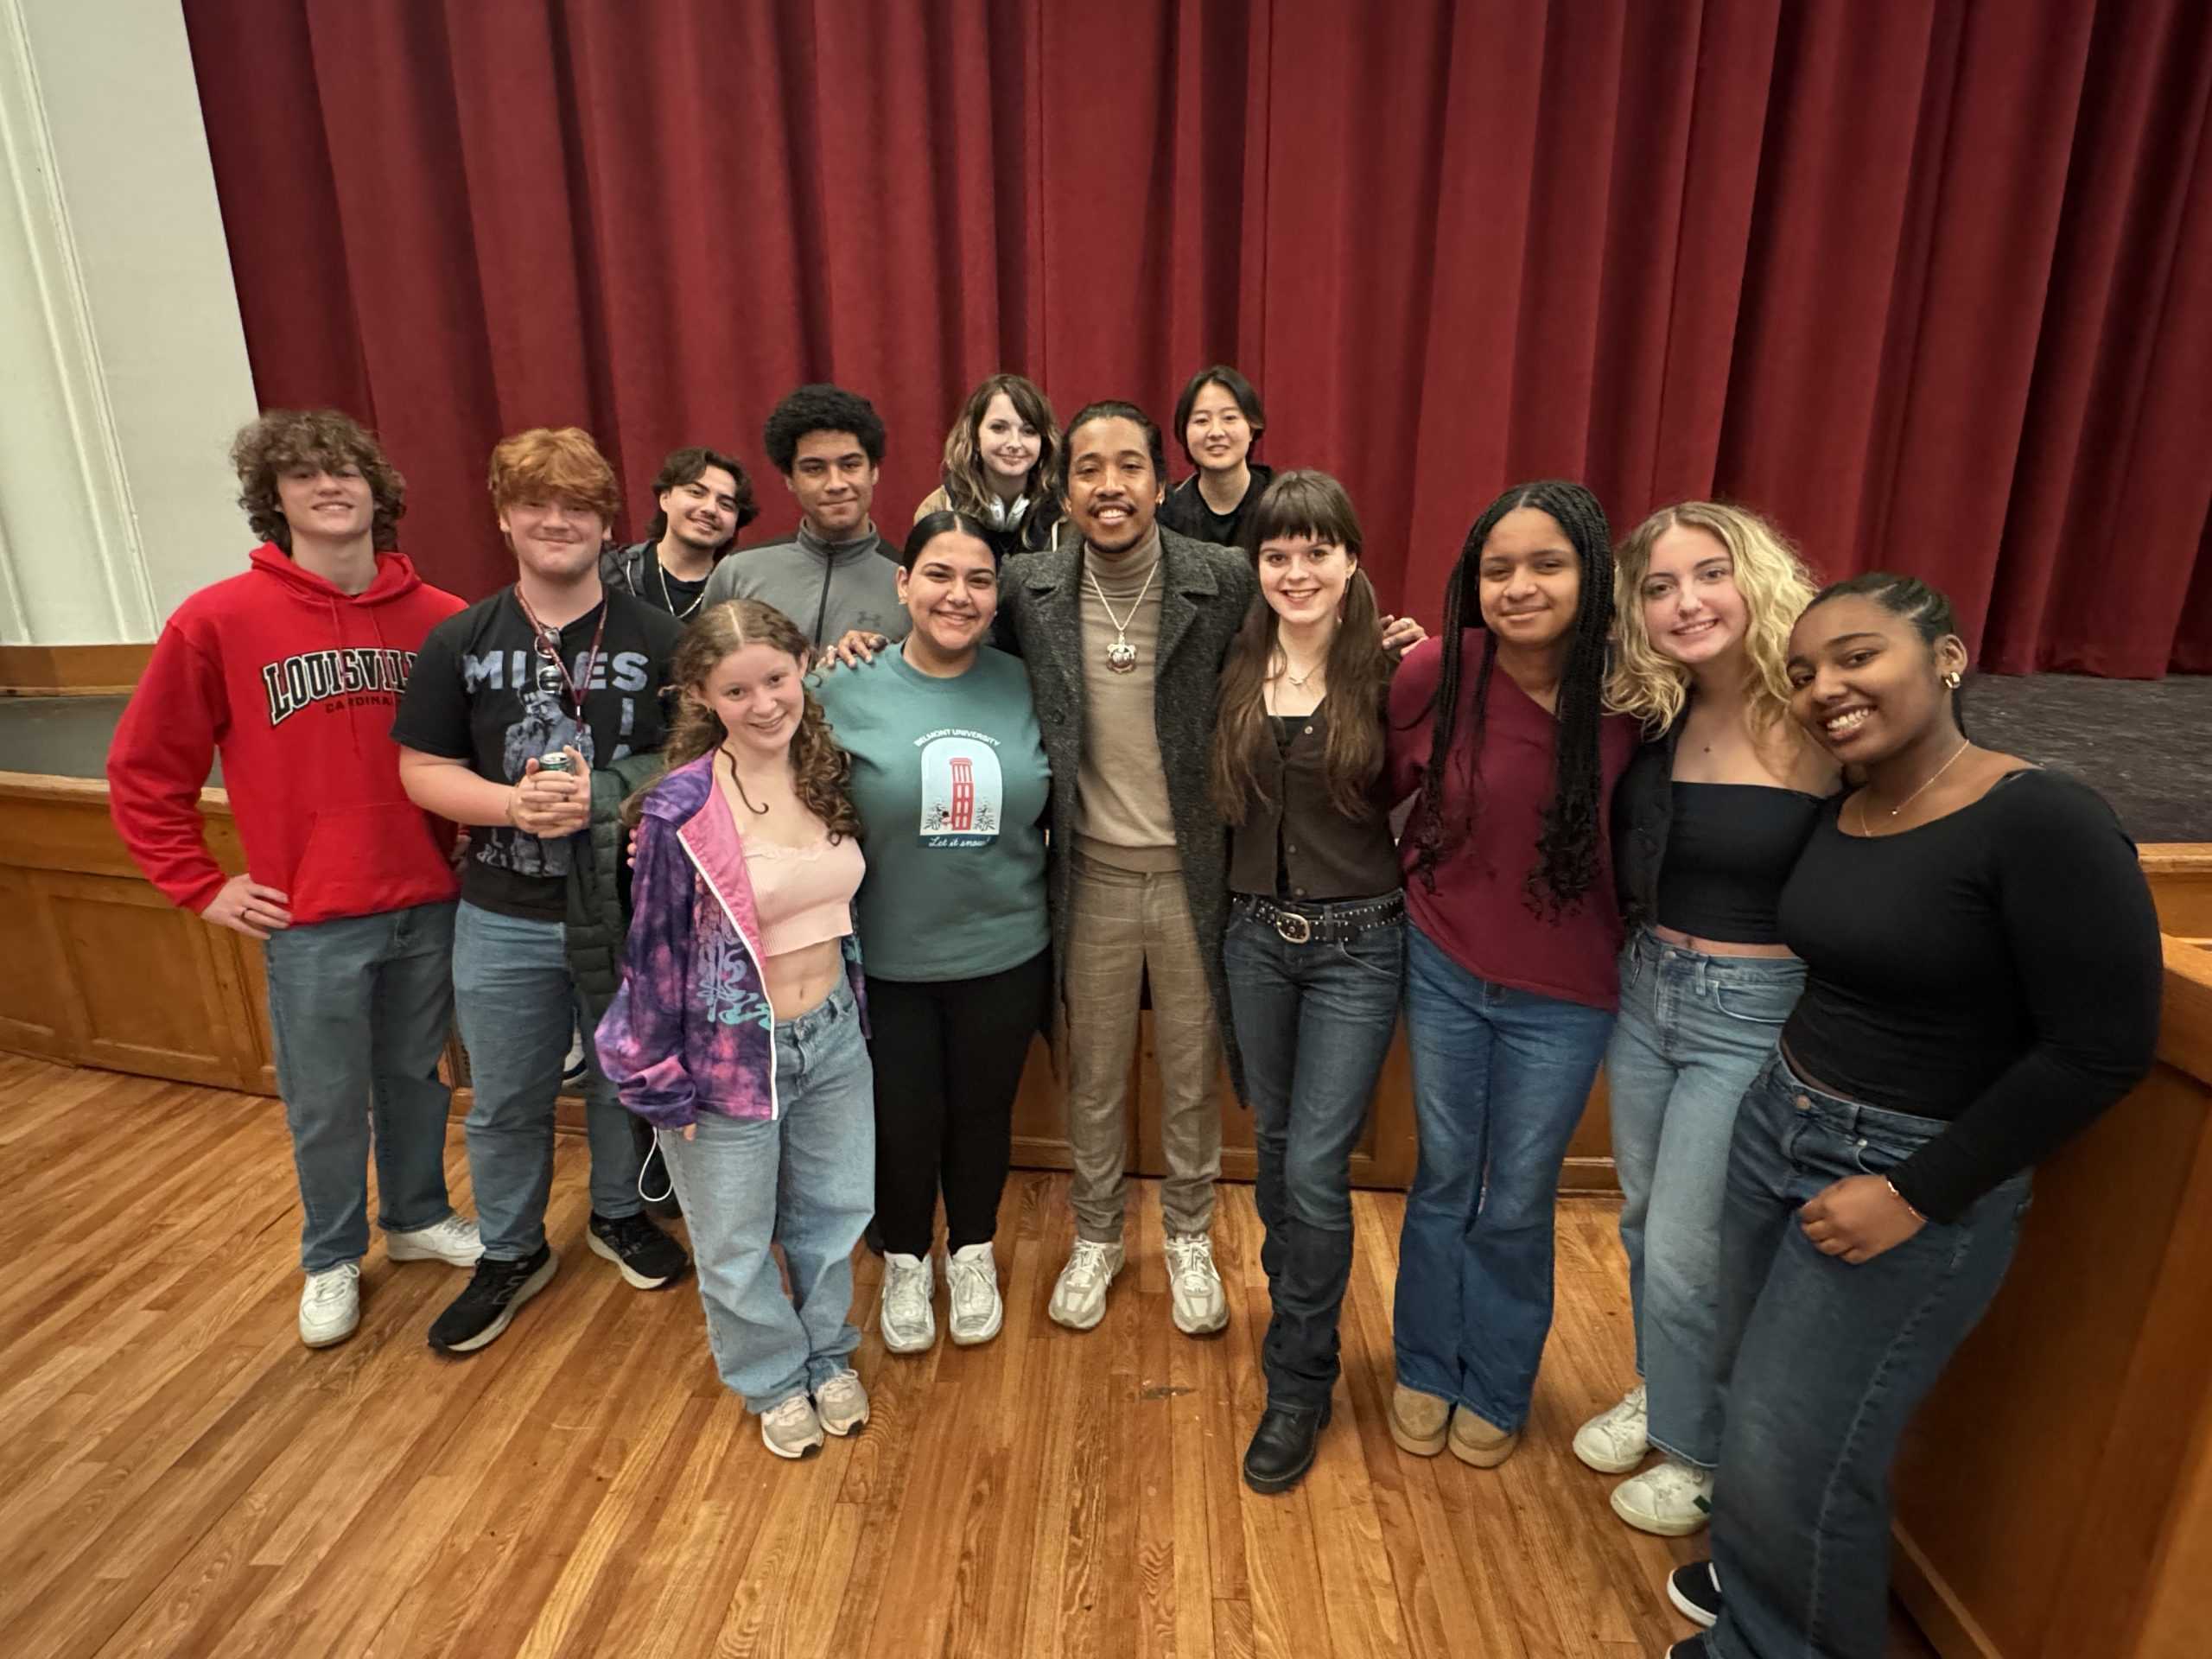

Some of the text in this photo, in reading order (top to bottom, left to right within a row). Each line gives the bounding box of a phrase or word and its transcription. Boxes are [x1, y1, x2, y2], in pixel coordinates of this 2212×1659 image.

[263, 648, 419, 727] LOUISVIL
[913, 728, 1001, 747] BELMONT UNIVERSITY
[928, 836, 948, 847] Let
[949, 837, 959, 847] it
